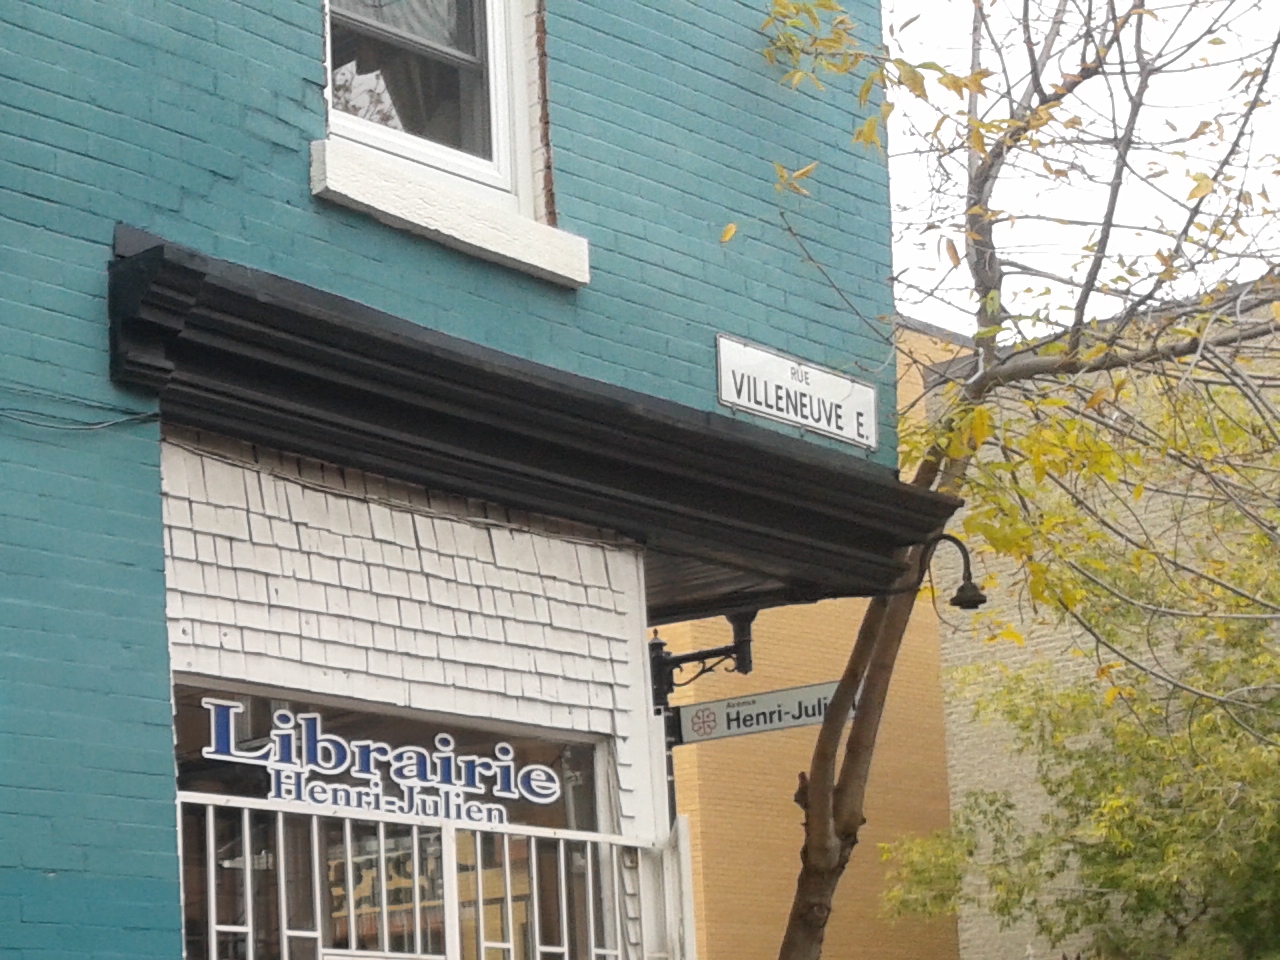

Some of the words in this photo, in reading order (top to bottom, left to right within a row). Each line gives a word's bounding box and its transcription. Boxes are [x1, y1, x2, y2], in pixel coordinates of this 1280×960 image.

[732, 369, 844, 431] VILLENEUVE
[790, 367, 810, 386] RUE
[726, 697, 856, 731] Henri-Juli
[201, 697, 562, 804] Librairie
[267, 766, 508, 825] Henri-Julien
